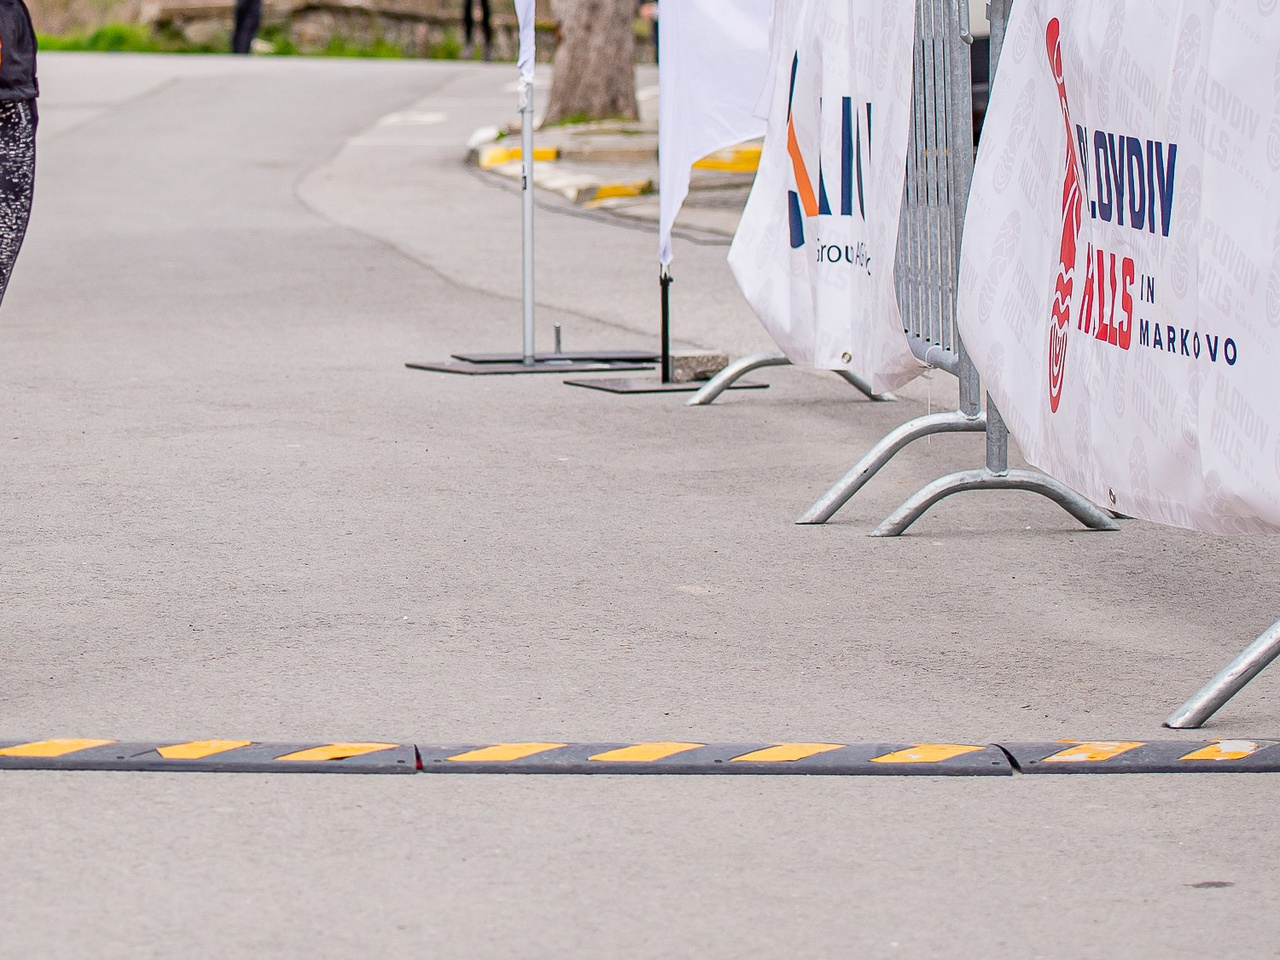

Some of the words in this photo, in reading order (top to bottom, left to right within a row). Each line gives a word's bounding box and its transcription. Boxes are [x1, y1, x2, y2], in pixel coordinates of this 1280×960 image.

[1077, 242, 1134, 351] HLLS
[1140, 274, 1155, 304] IN
[1140, 318, 1237, 365] MARKOVO
